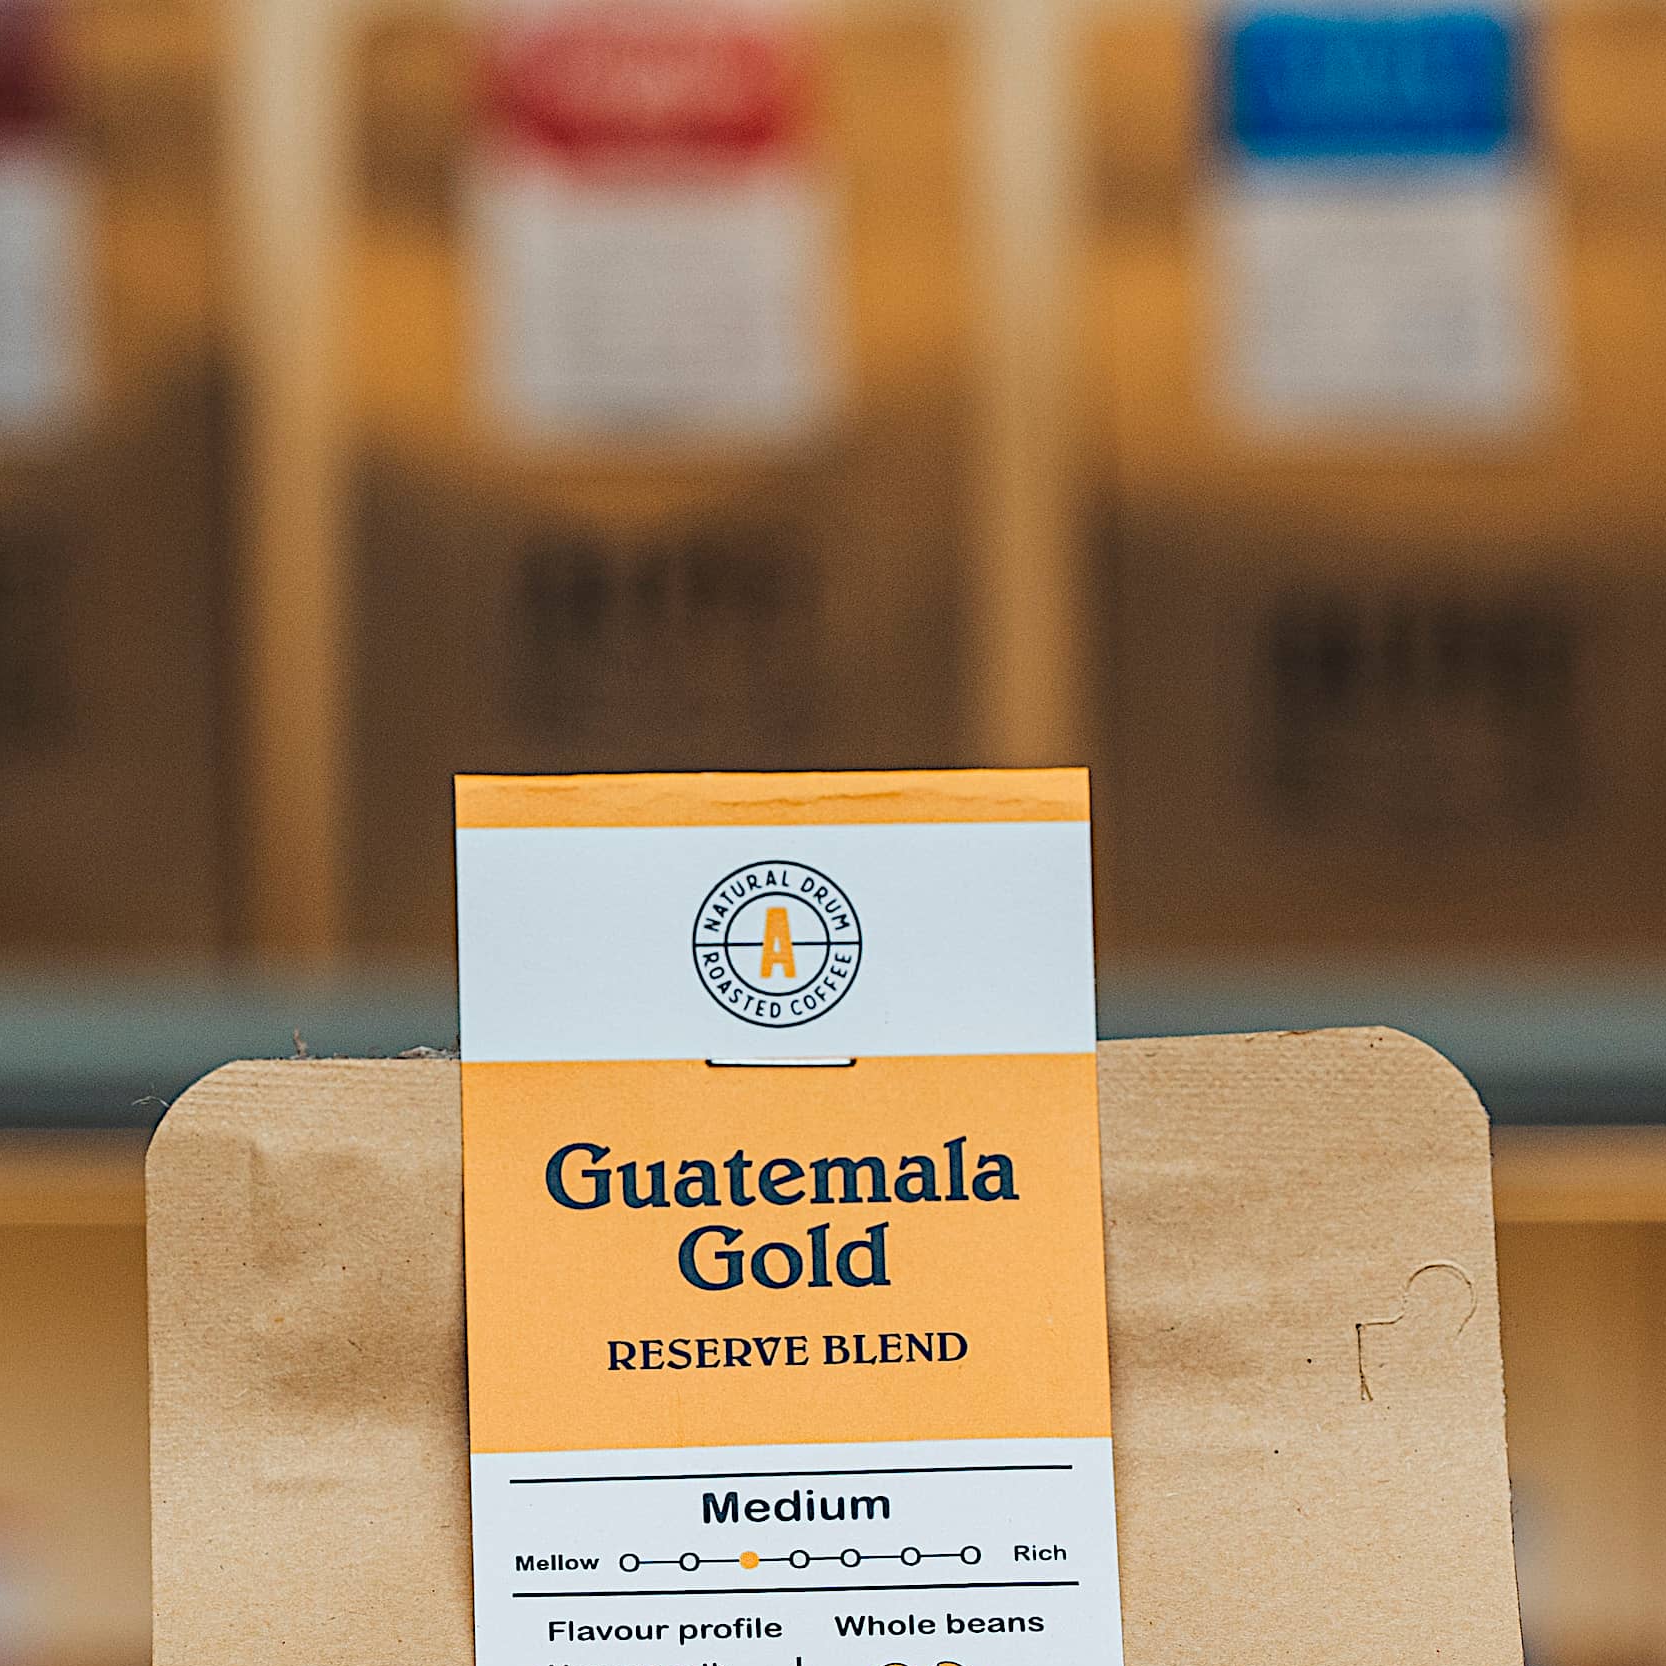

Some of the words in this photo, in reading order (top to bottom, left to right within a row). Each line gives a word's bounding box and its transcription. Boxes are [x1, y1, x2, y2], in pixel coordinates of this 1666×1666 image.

[704, 870, 789, 932] NATURAL
[801, 877, 850, 931] DRUM
[760, 907, 797, 978] A
[703, 952, 781, 1018] ROASTED
[791, 953, 851, 1015] COFFEE
[545, 1135, 1020, 1211] Guatemala
[678, 1221, 892, 1292] Gold
[607, 1335, 810, 1371] RESERVE
[822, 1332, 968, 1366] BLEND
[702, 1489, 890, 1524] Medium
[515, 1554, 600, 1572] Mellow
[1013, 1544, 1067, 1562] Rich
[548, 1620, 670, 1642] Flavour
[679, 1617, 783, 1646] profile
[834, 1613, 936, 1637] Whole
[946, 1613, 1045, 1635] beans
